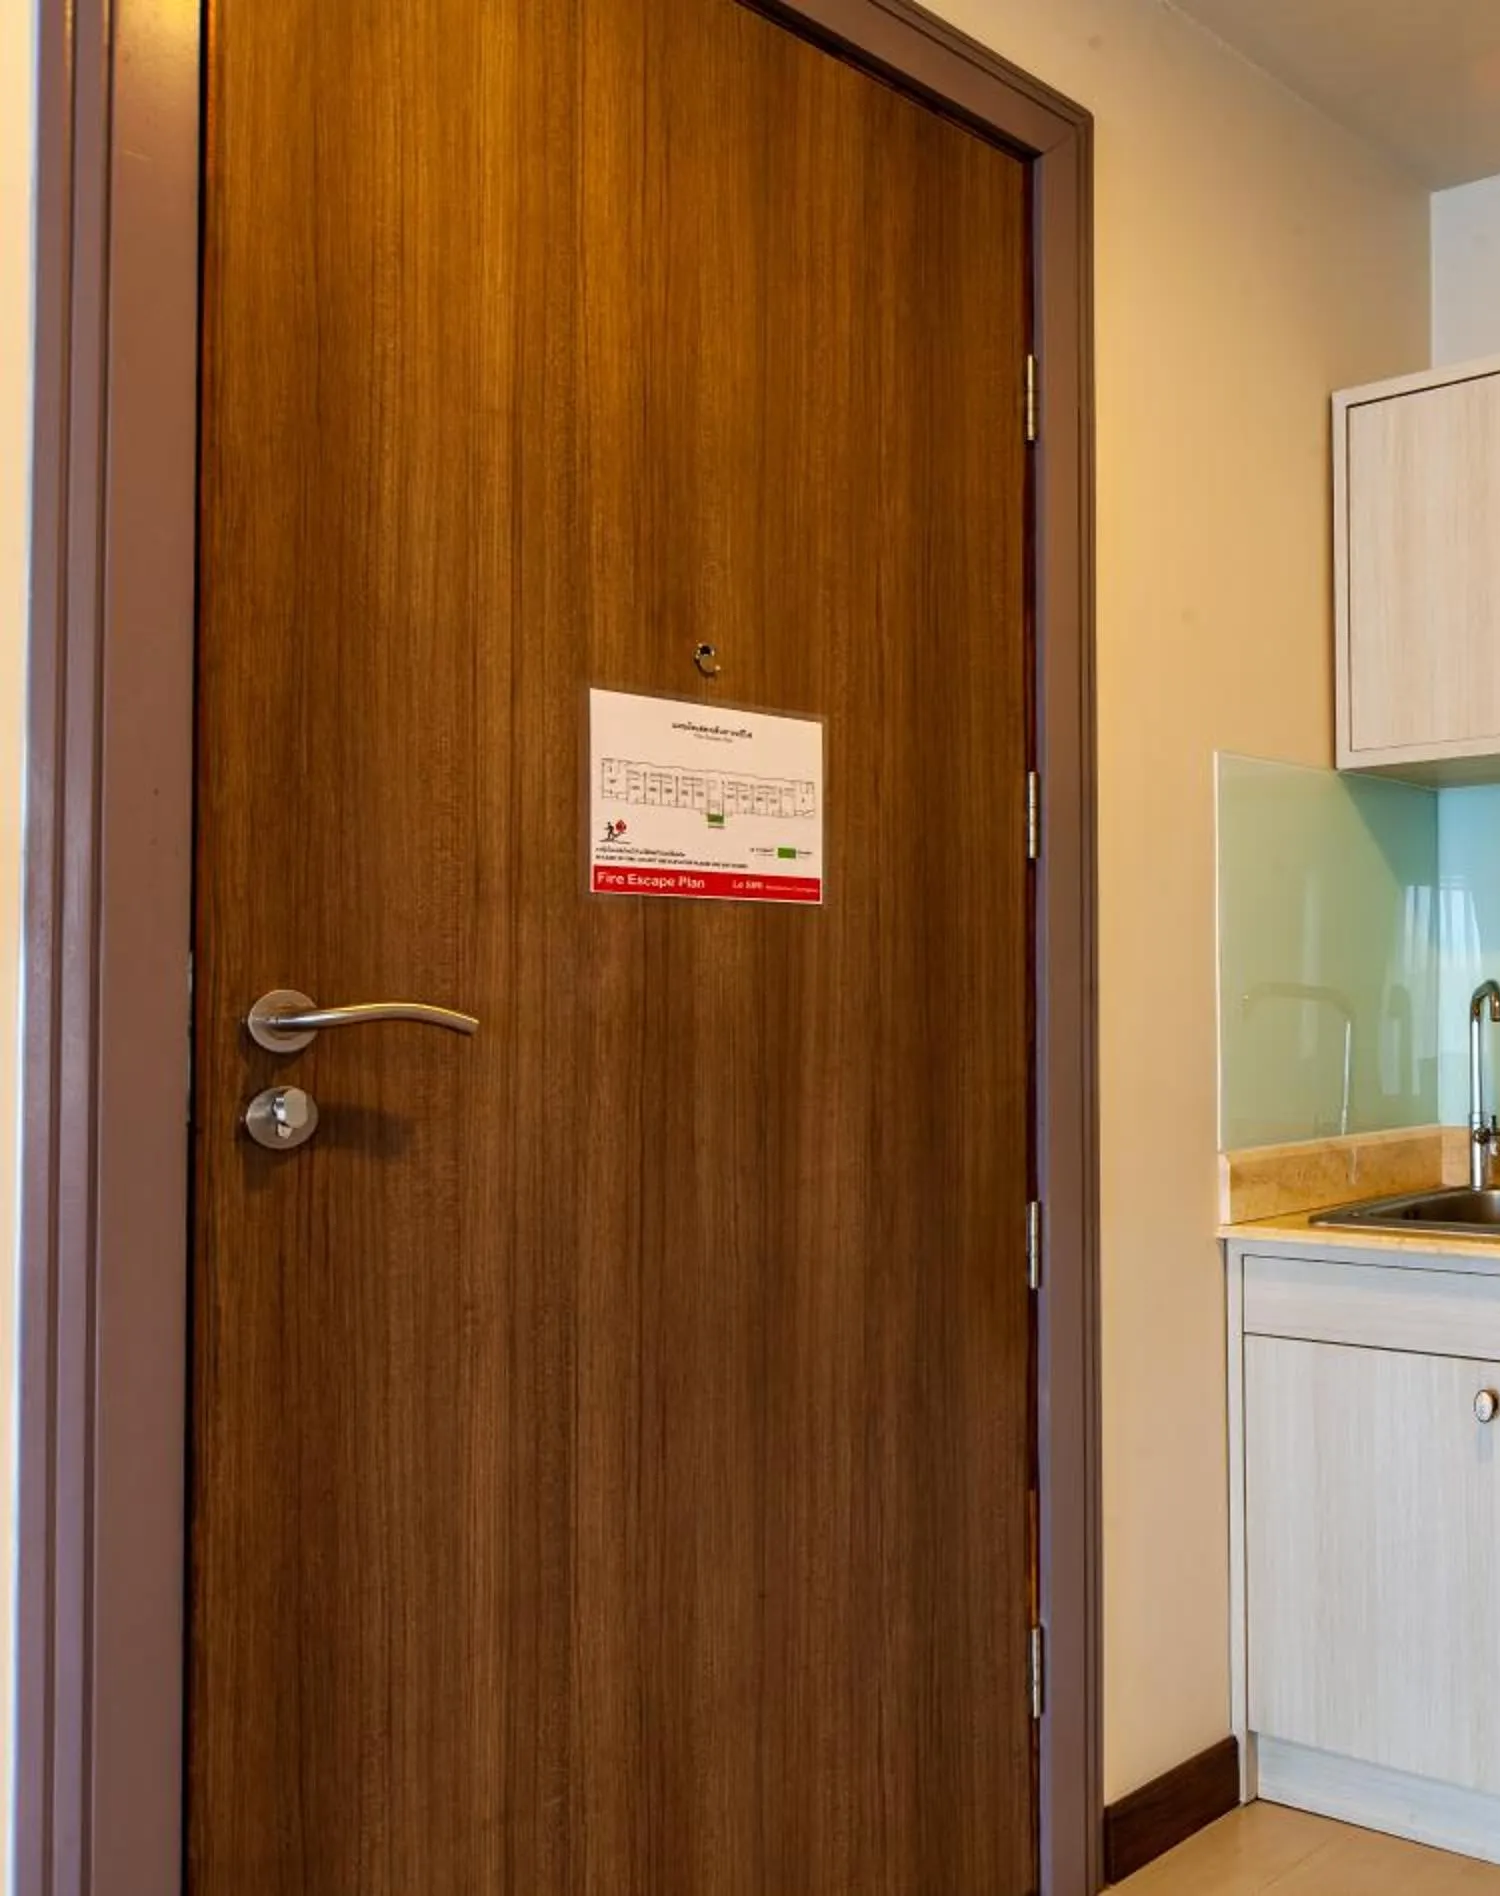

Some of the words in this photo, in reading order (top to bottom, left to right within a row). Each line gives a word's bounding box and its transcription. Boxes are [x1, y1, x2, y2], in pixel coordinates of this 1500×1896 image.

[597, 871, 625, 885] Fire
[627, 873, 676, 889] Escape
[678, 875, 705, 889] Plan
